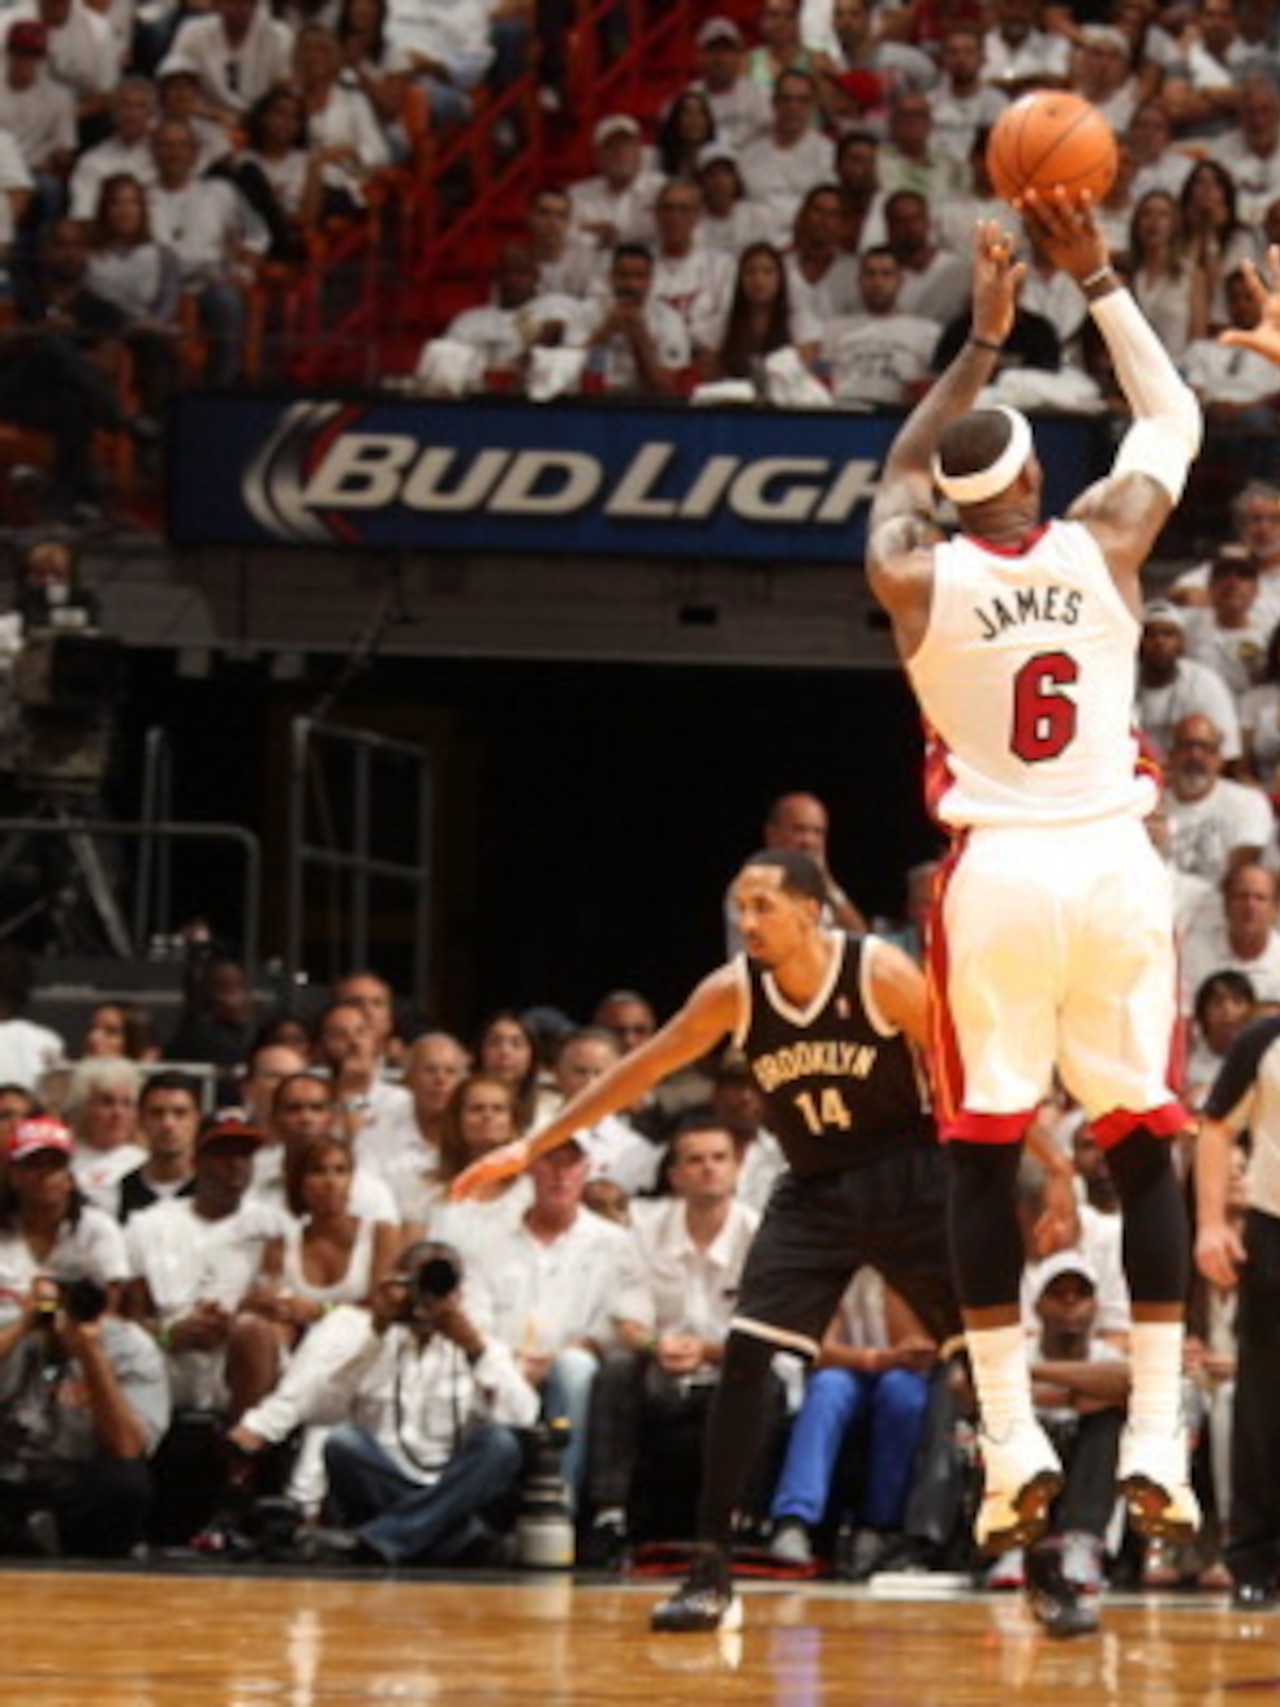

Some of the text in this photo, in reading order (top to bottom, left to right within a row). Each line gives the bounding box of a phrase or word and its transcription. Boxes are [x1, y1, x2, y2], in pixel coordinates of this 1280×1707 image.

[303, 434, 883, 522] BUD LIGH
[974, 586, 1083, 640] JAMES
[1010, 652, 1079, 765] 6
[753, 1041, 877, 1093] BROOKLYN
[795, 1087, 851, 1136] 14
